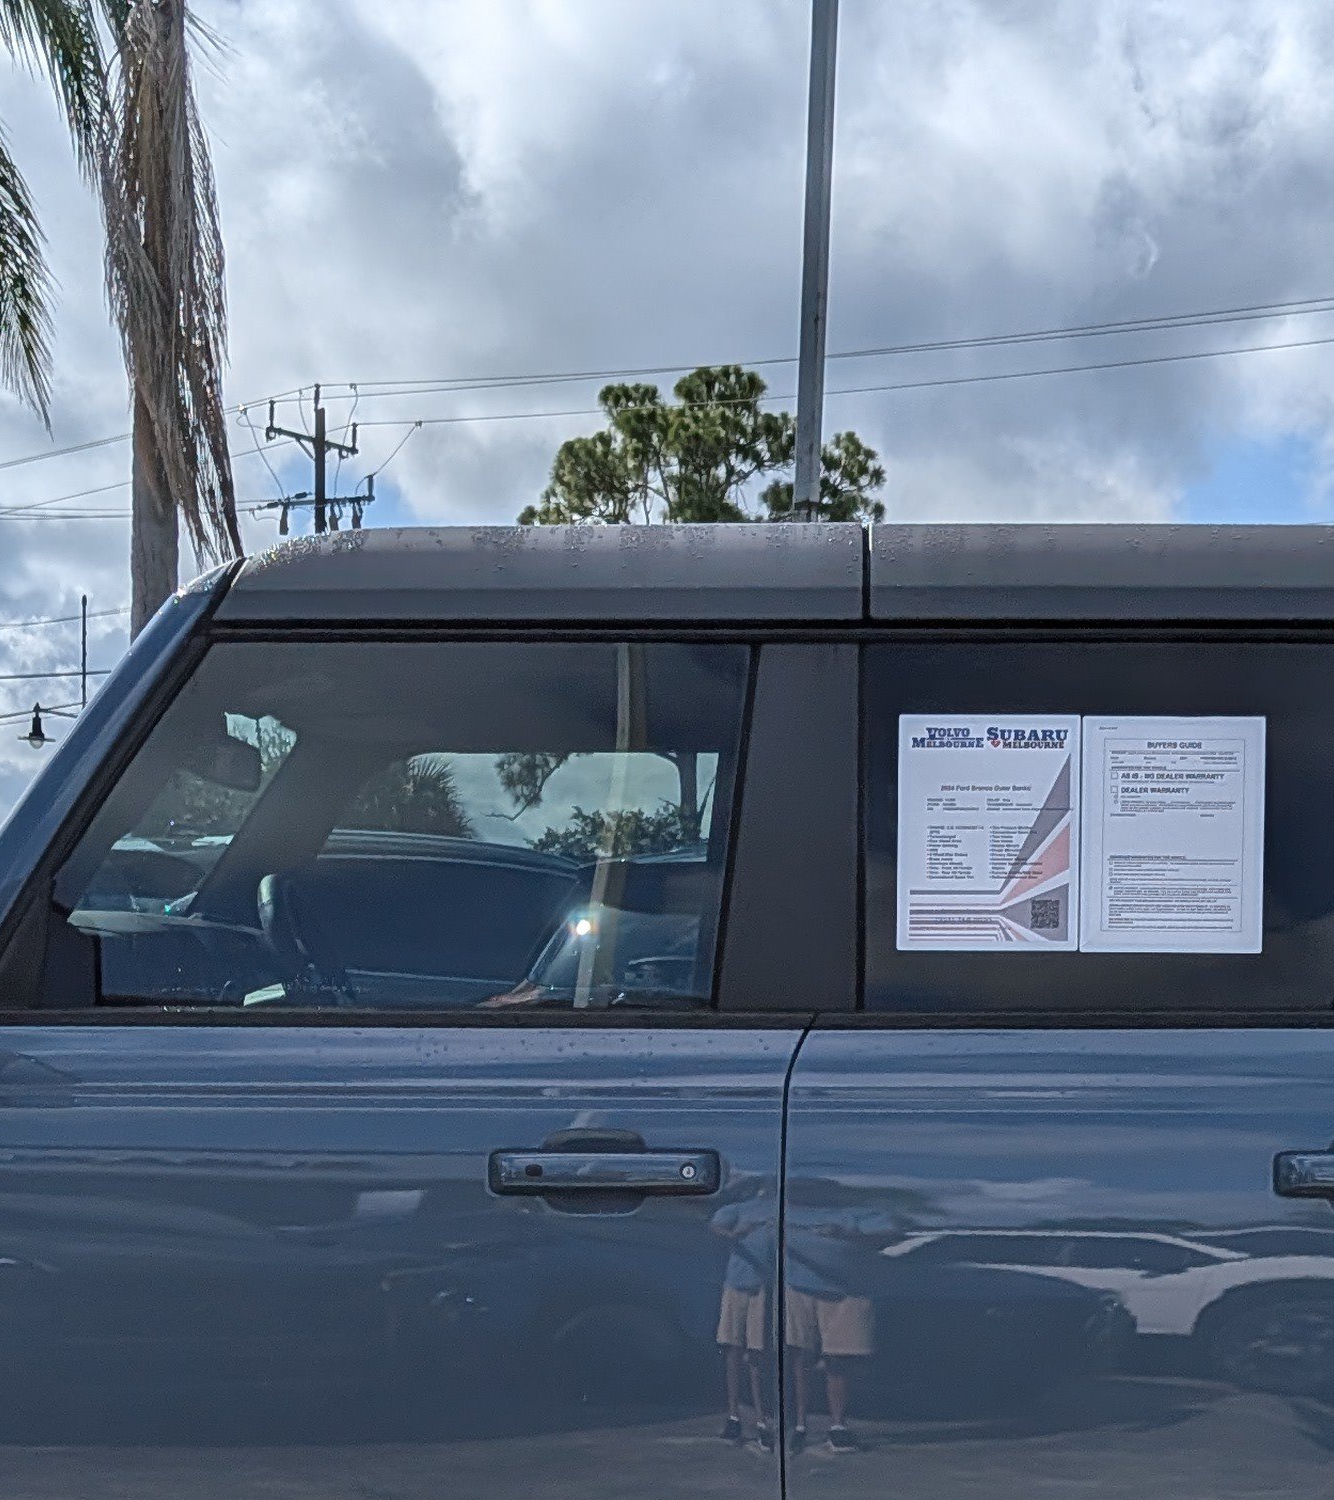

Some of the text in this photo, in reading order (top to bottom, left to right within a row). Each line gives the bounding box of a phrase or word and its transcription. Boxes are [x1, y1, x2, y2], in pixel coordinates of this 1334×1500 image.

[925, 727, 971, 741] VOLVO
[986, 727, 1069, 741] SUBARU
[911, 737, 984, 748] MELBOURNE
[1002, 740, 1065, 749] MELBOURNE
